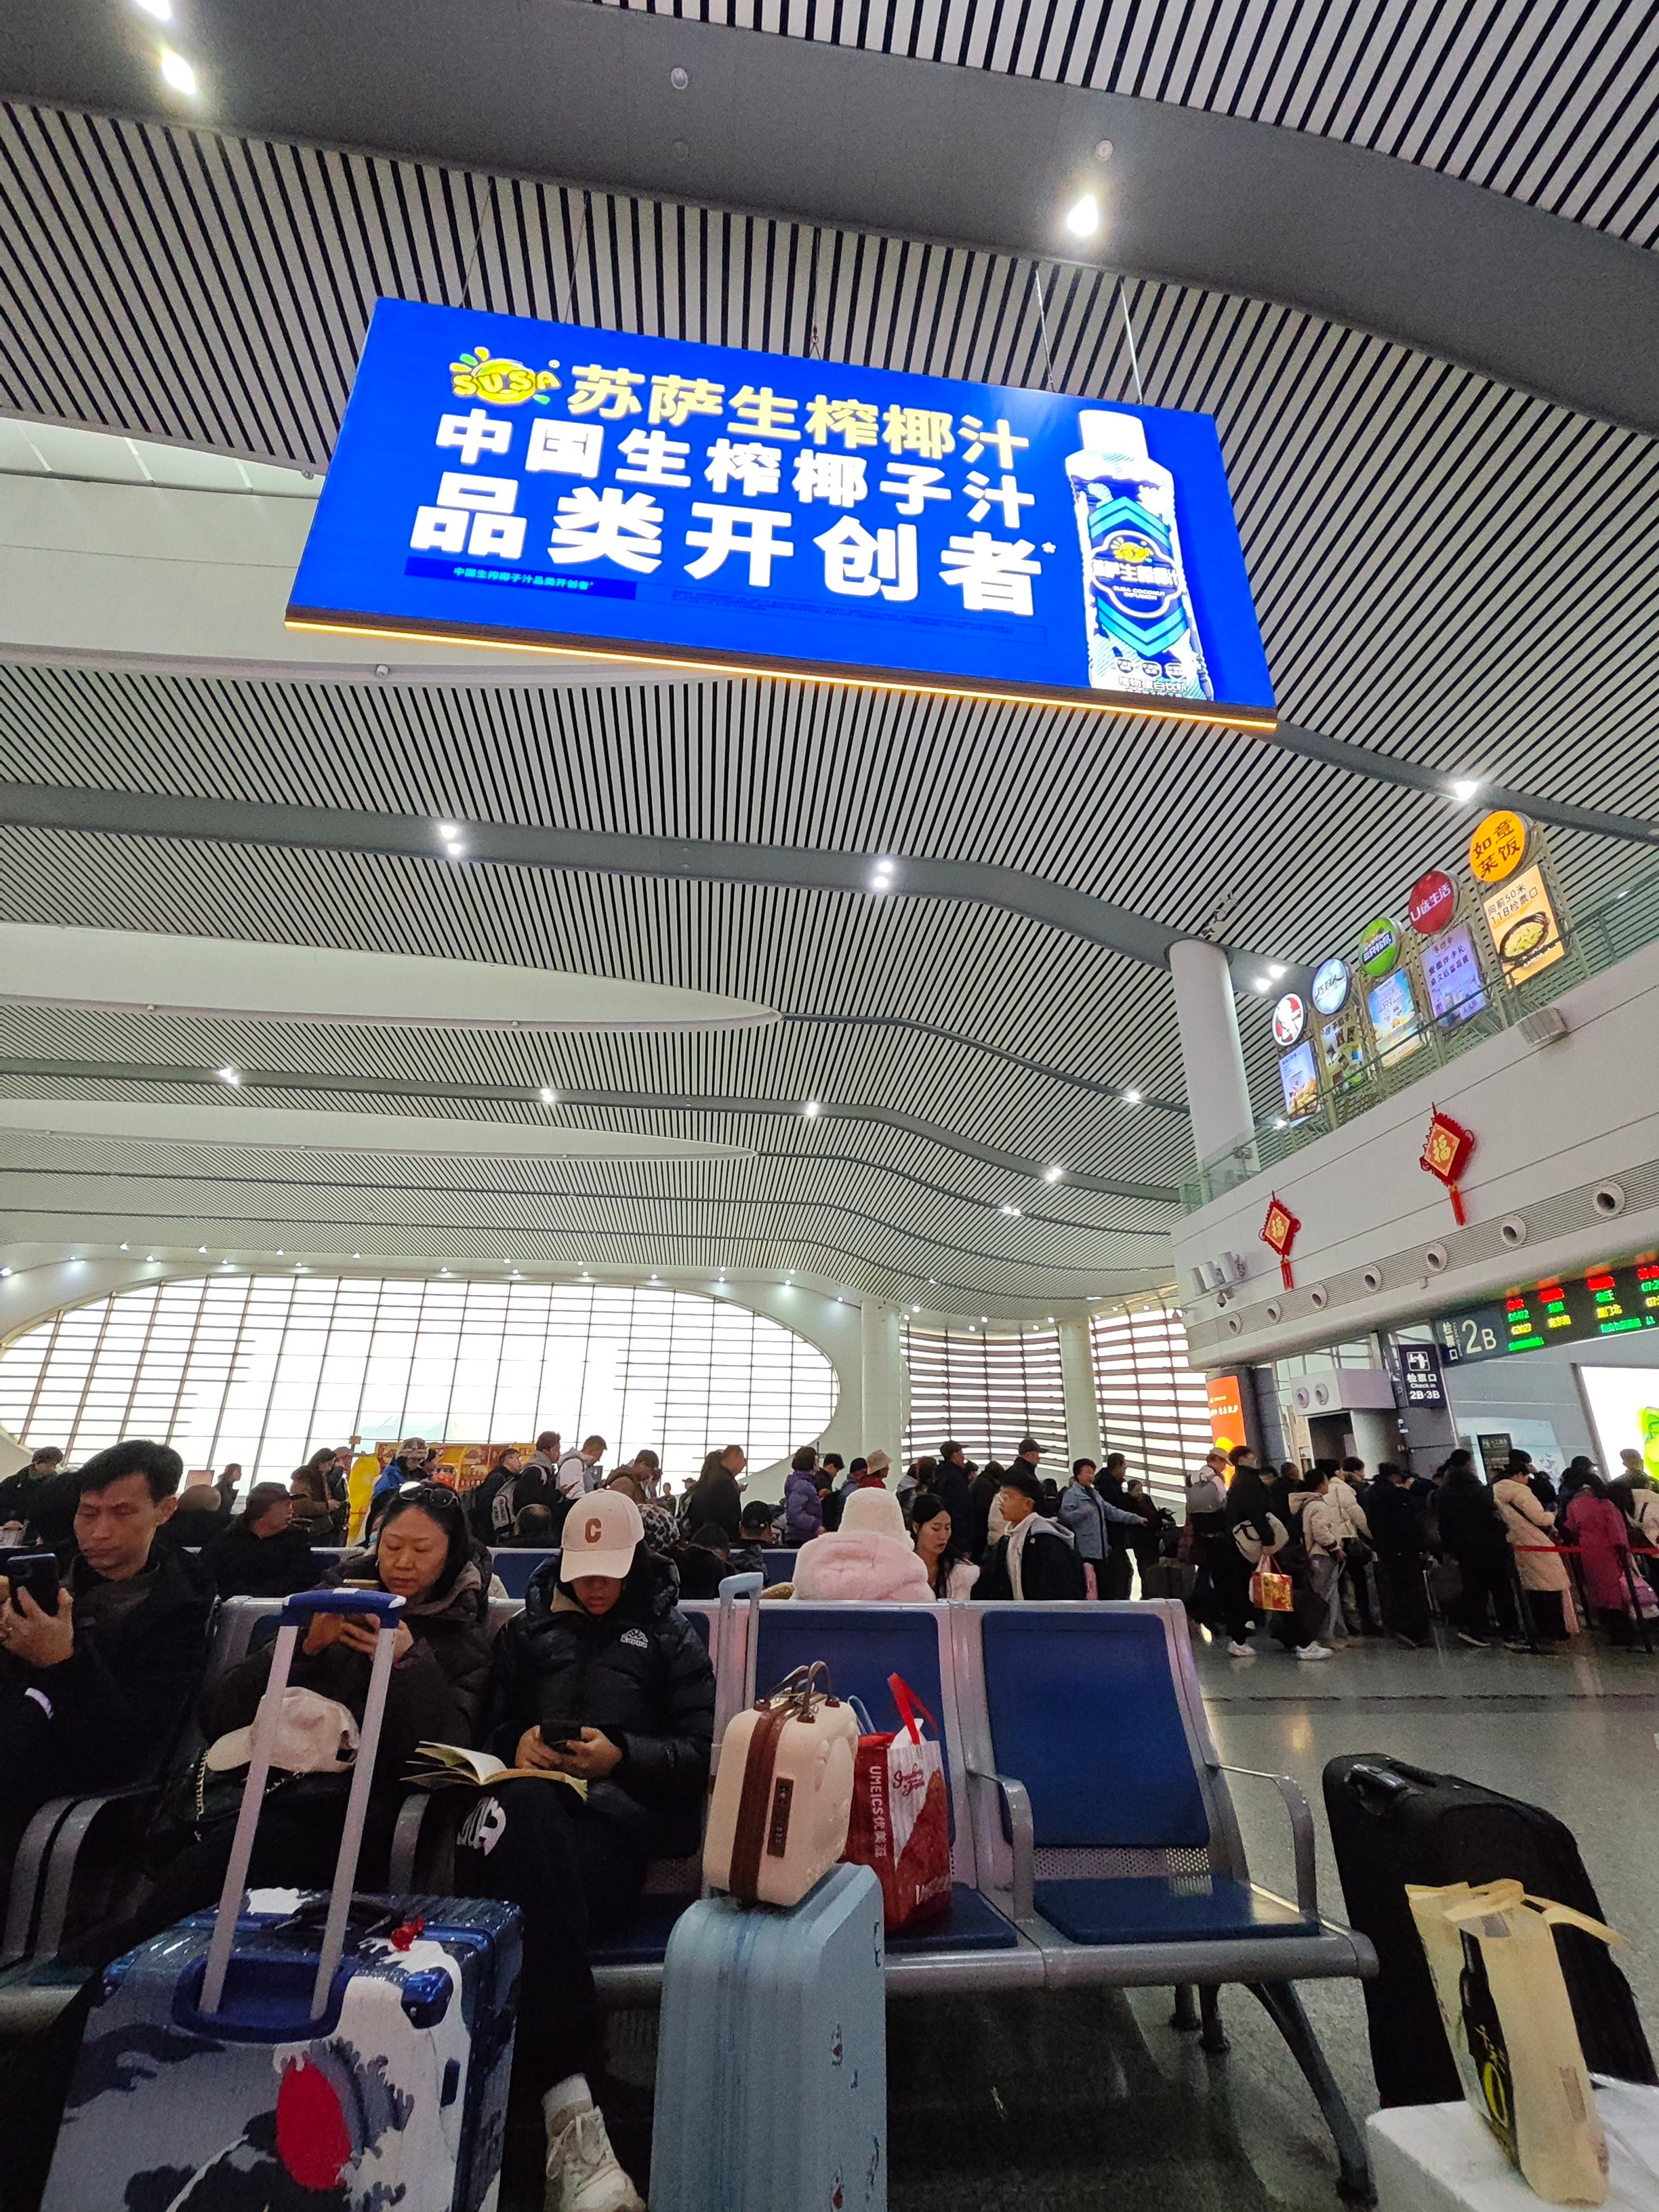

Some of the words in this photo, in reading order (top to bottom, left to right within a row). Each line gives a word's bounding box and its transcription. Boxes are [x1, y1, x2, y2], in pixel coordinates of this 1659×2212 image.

[453, 370, 562, 396] SUSA
[567, 364, 1029, 469] 苏萨生榨椰汁
[436, 408, 1036, 529] 中国生榨椰子汁
[409, 472, 1042, 616] 品类开创者
[1473, 819, 1514, 859] 如意
[1477, 837, 1521, 879] 菜饭
[1488, 883, 1527, 914] 向前50米
[1490, 886, 1538, 925] 11B检票口
[1443, 1322, 1458, 1361] 检票口
[1462, 1319, 1497, 1354] 2B
[1407, 1373, 1437, 1382] 检票口
[585, 1518, 602, 1543] C
